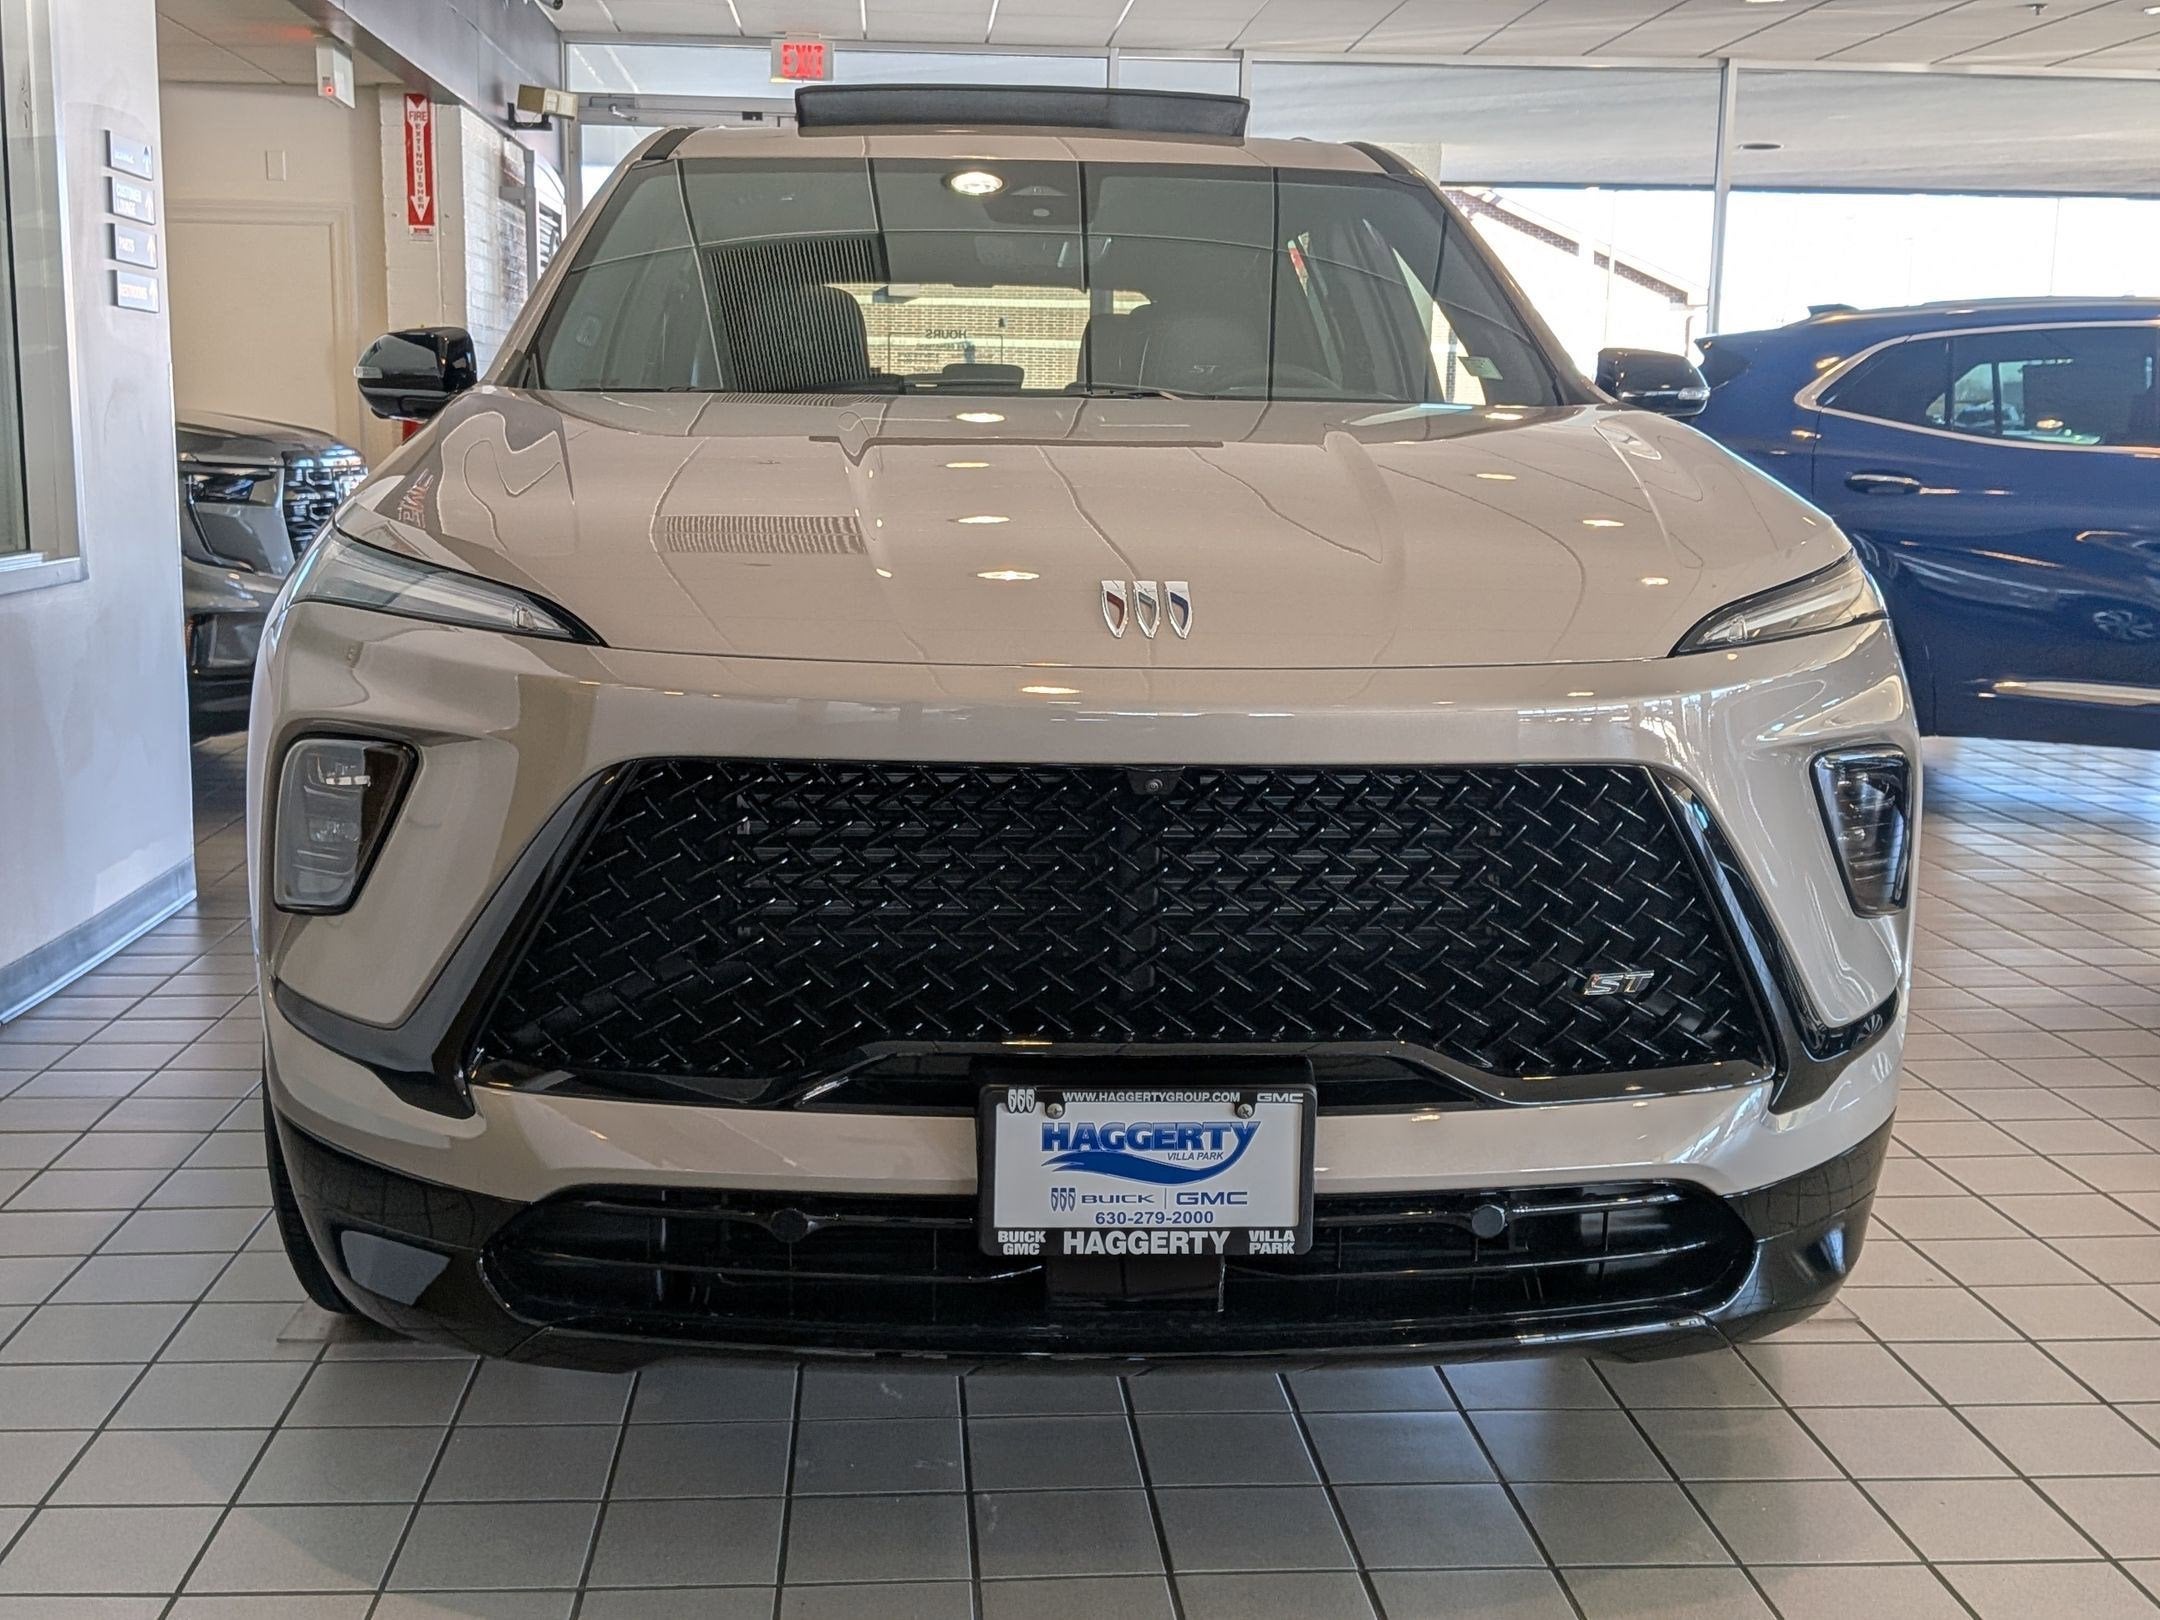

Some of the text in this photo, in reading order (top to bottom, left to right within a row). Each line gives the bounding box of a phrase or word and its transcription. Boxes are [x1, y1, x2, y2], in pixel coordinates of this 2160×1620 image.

[782, 44, 823, 79] EXIT
[409, 111, 427, 121] FIRE
[415, 123, 425, 210] EXTINGUISHER
[1584, 970, 1655, 995] ST
[1062, 1092, 1241, 1103] WWW.HAGGERTYGROUP.COM
[1257, 1093, 1304, 1102] GMC
[1041, 1121, 1262, 1152] HAGGERTY
[1167, 1152, 1224, 1161] VILLA PARK
[1081, 1191, 1248, 1205] BUICK GMC
[1095, 1211, 1214, 1225] 630-279-2000
[998, 1231, 1047, 1244] BUICK
[1063, 1231, 1232, 1255] HAGGERTY
[1249, 1230, 1296, 1243] VILLA
[1003, 1243, 1040, 1256] GMC
[1249, 1242, 1296, 1255] PARK
